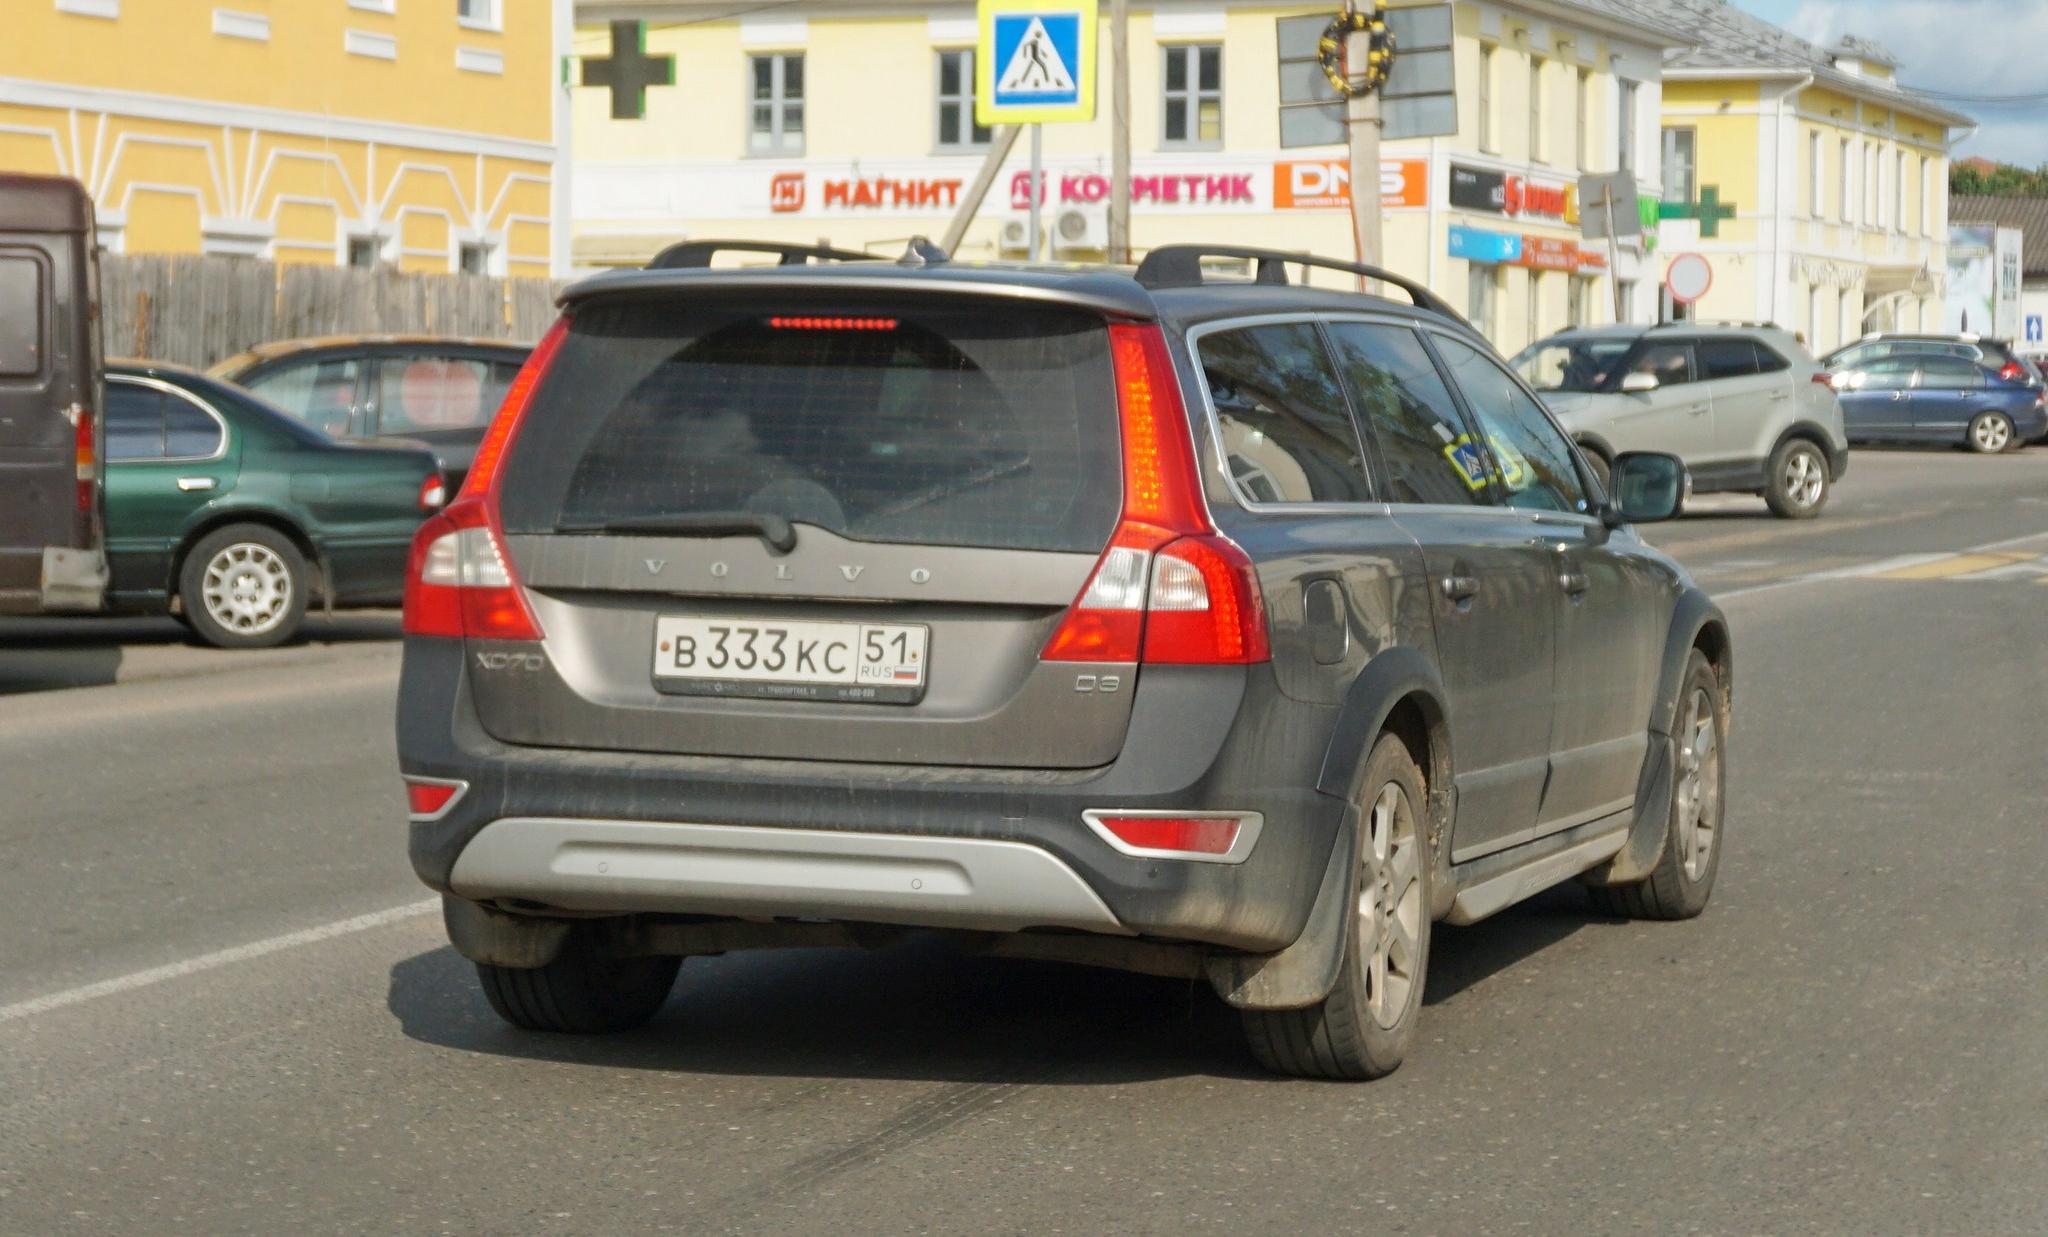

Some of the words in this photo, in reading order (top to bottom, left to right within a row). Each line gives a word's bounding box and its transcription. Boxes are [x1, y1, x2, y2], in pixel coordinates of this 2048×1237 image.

[823, 179, 962, 207] МАГНИТ
[1060, 173, 1255, 204] КОМЕТИК
[645, 558, 931, 584] VOLVO
[864, 629, 909, 665] 51
[476, 651, 545, 672] XC70
[860, 665, 893, 679] RUS
